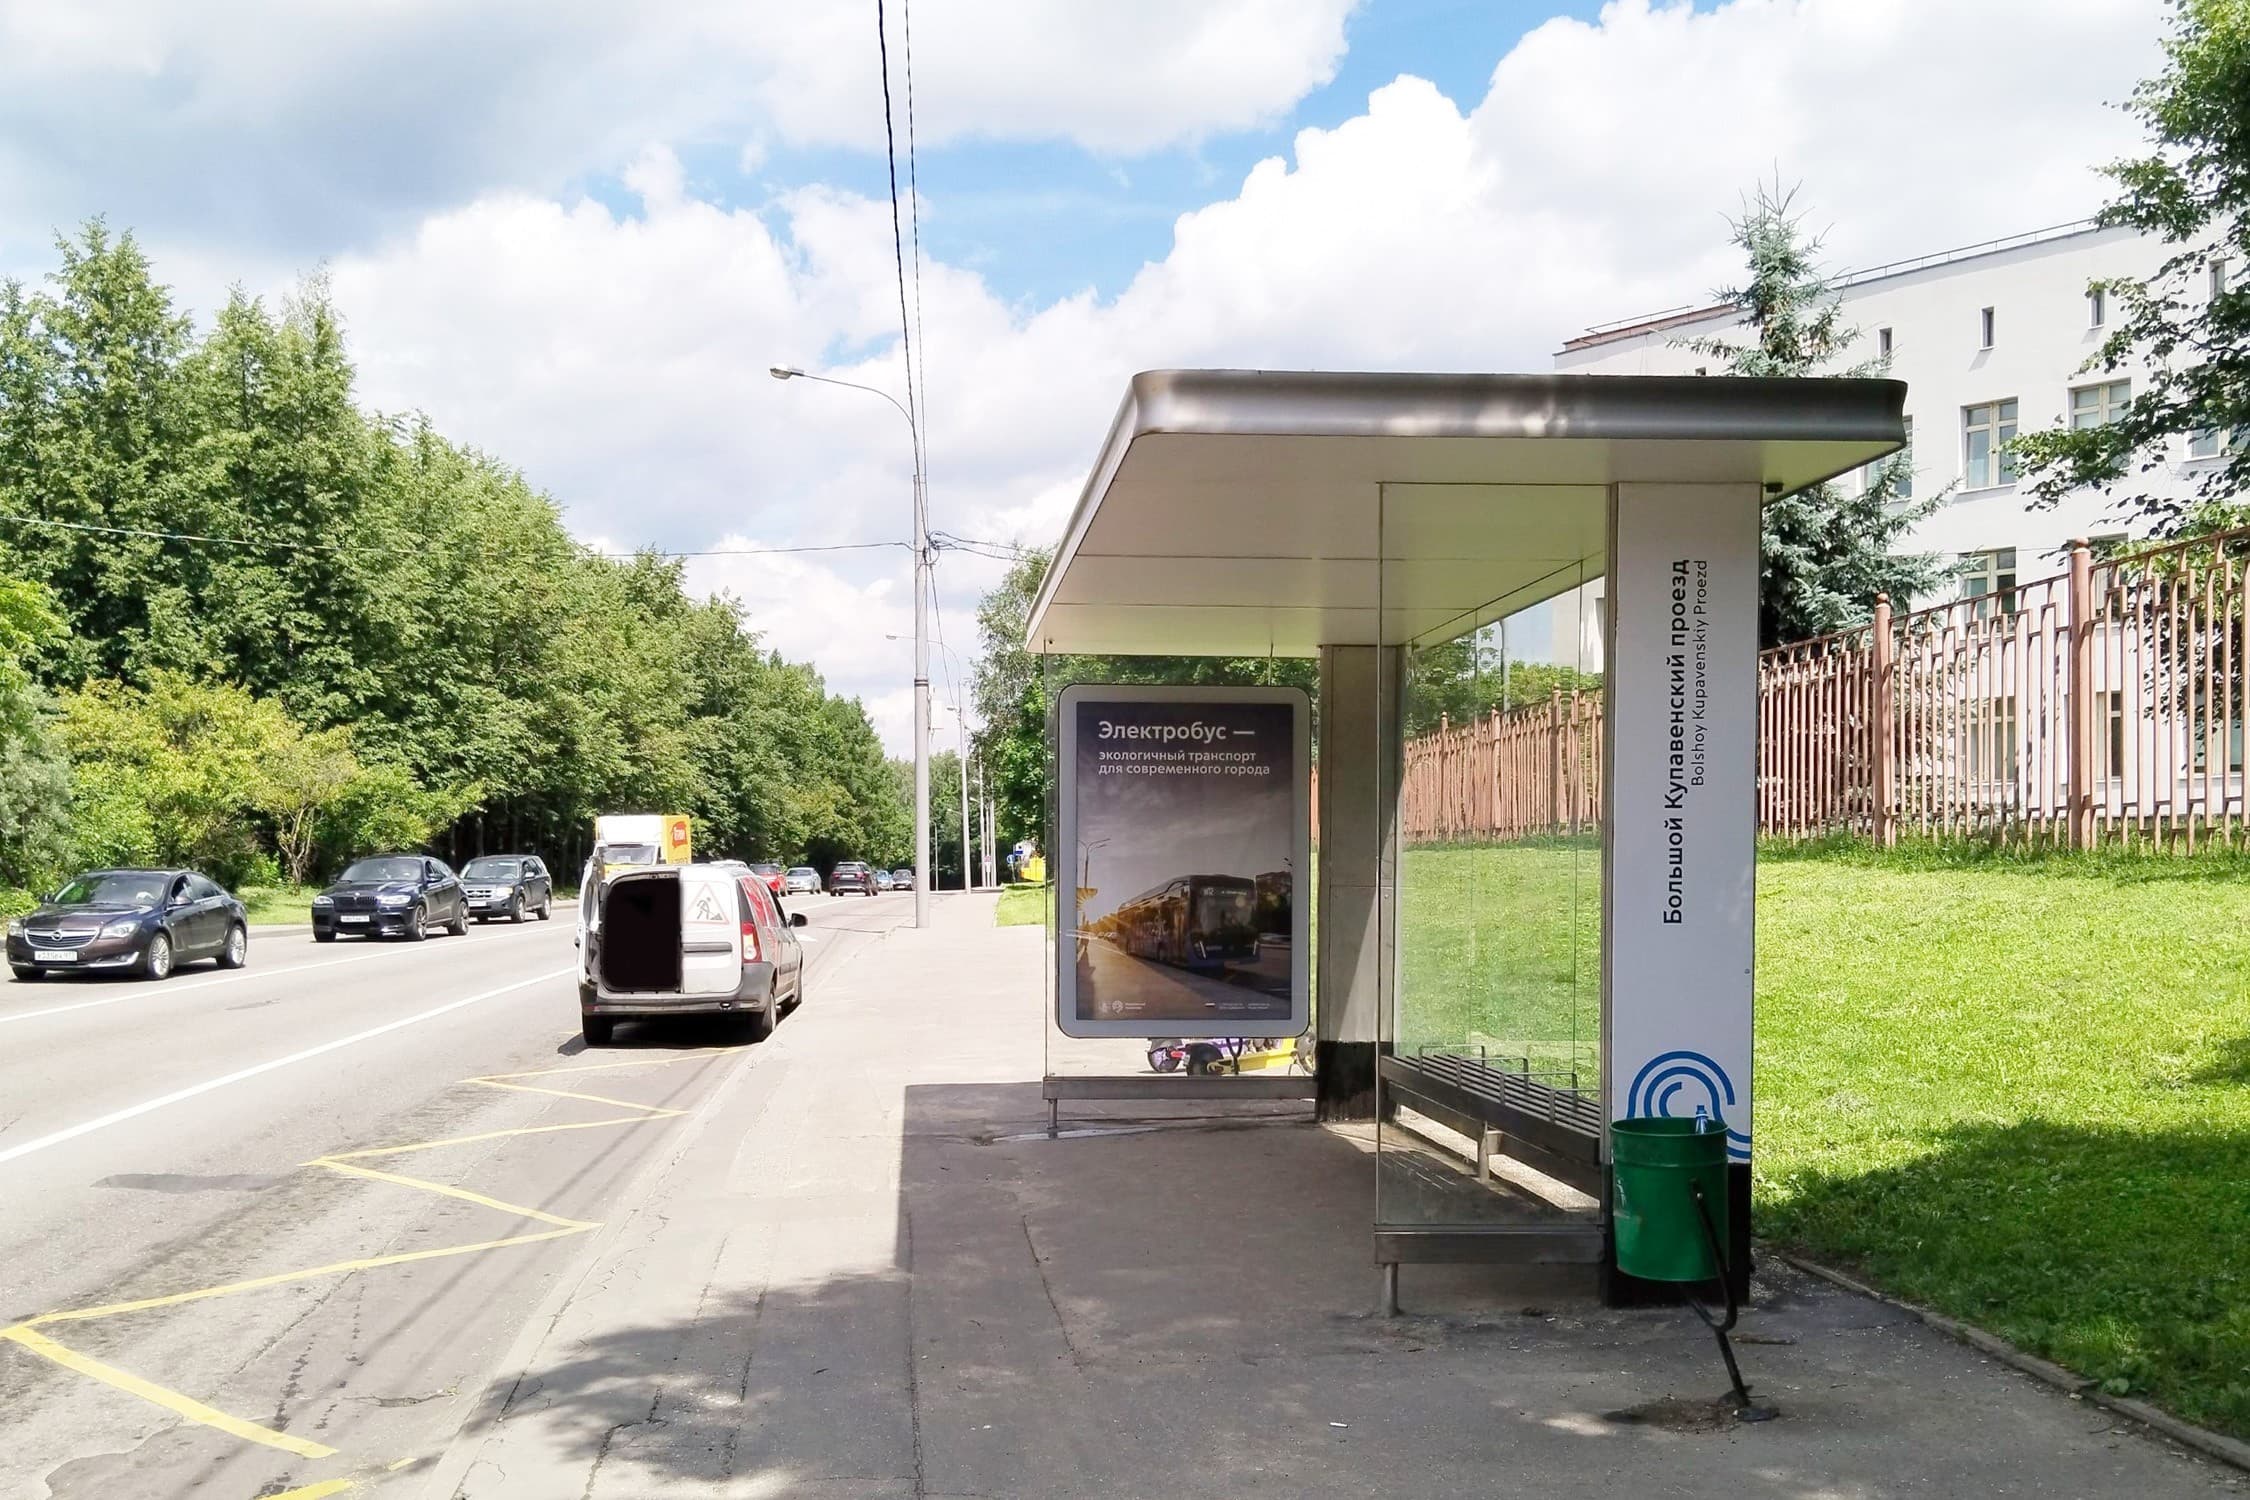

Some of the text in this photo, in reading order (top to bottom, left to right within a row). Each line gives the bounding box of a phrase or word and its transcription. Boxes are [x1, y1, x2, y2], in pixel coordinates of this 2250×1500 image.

[1690, 559, 1710, 786] Bolshoy Kupavenskiy Proezd
[1098, 720, 1227, 744] Электробус
[1663, 559, 1691, 924] Большой Купавенский проезд
[1098, 750, 1256, 764] экологичный транспорт
[1098, 764, 1271, 777] для современного города
